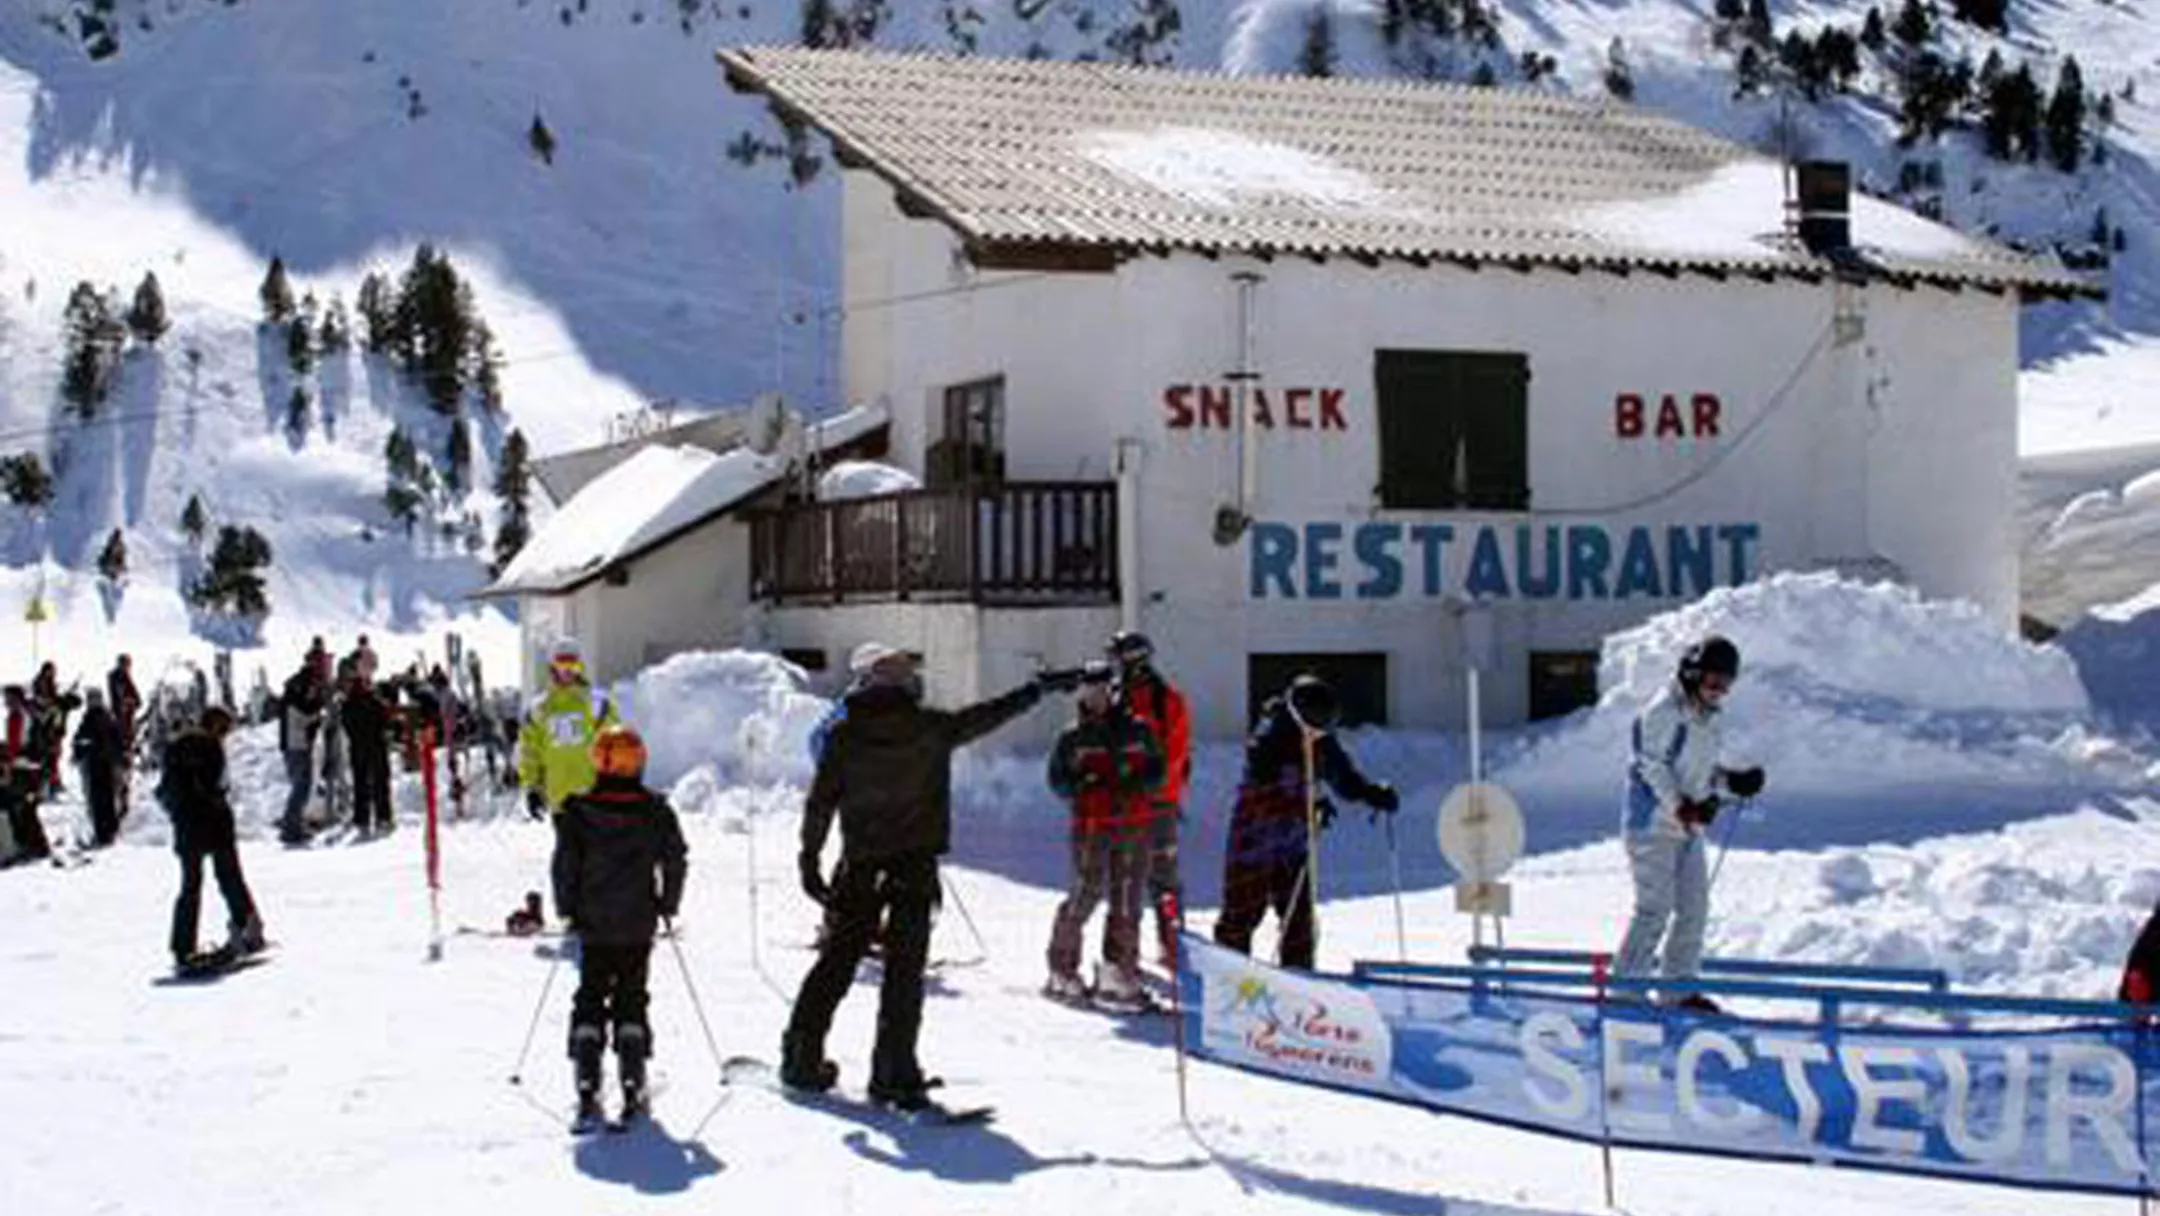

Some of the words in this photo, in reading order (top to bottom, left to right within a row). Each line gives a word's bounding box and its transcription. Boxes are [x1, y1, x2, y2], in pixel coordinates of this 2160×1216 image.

[1164, 384, 1347, 430] SNACK
[1616, 392, 1721, 438] BAR
[1250, 522, 1759, 598] RESTAURANT
[1520, 1010, 2148, 1176] SECTEUR
